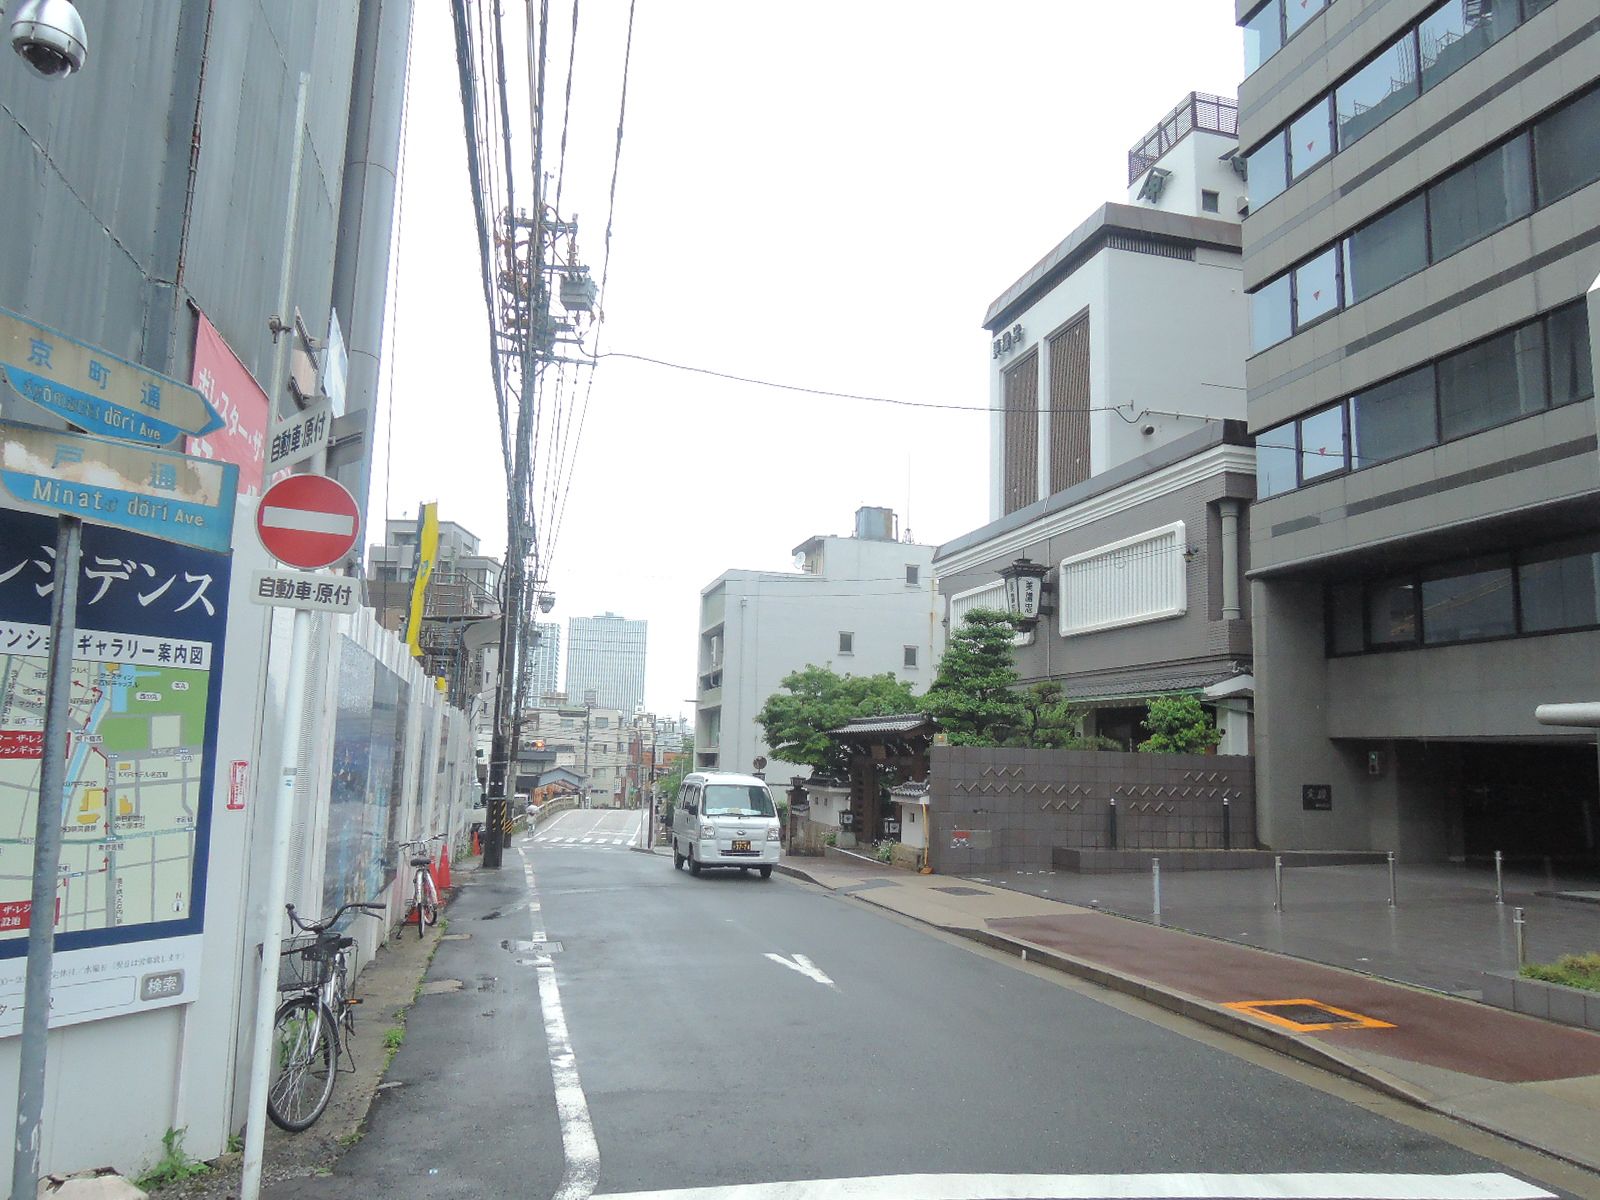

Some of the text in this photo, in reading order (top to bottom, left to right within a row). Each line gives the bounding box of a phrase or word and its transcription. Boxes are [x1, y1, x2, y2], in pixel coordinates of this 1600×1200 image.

[27, 337, 161, 411] 京町通
[139, 422, 161, 441] Ave
[175, 509, 204, 526] Ave
[147, 976, 177, 993] 検索
